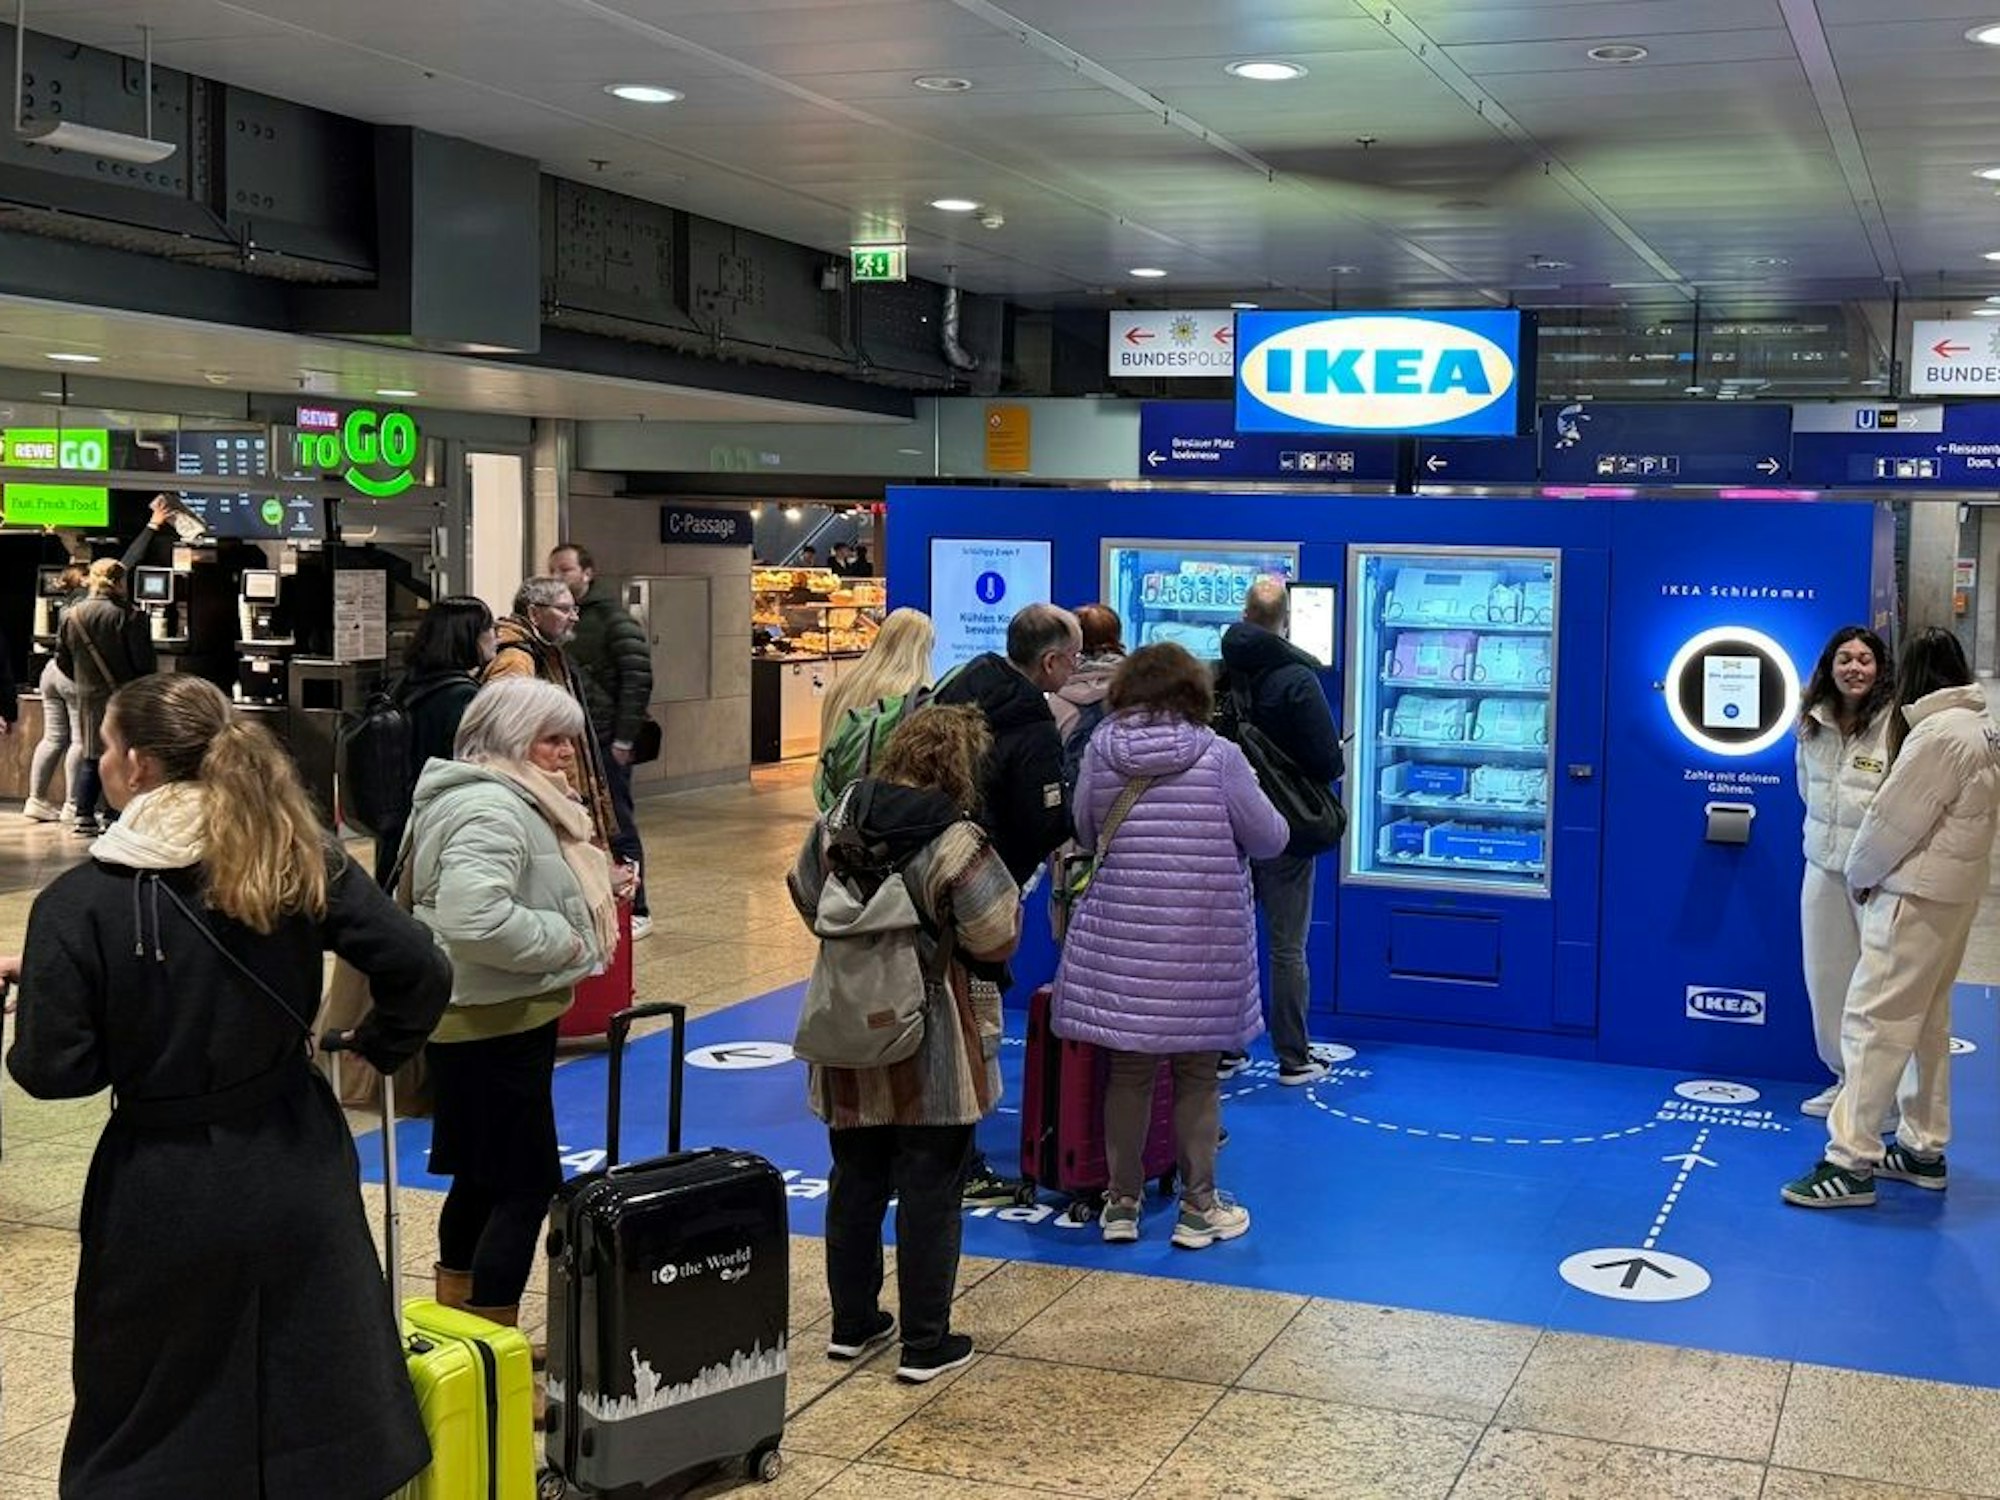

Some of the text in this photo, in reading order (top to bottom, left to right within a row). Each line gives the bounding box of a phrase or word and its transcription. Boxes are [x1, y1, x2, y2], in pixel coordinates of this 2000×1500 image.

[1121, 352, 1232, 367] BUNDESPOLIZ
[1265, 349, 1492, 396] IKEA
[300, 408, 339, 427] REWE
[1858, 410, 1874, 428] U
[297, 433, 341, 469] TO
[344, 408, 417, 468] GO
[1213, 438, 1235, 450] Platz
[15, 440, 102, 471] REWE GO
[669, 512, 737, 539] C-Passage
[1661, 585, 1816, 599] IKEA Schlafomat
[1684, 769, 1780, 785] Zahle mit deinem
[1707, 781, 1754, 795] Gähnen.
[1694, 994, 1759, 1014] IKEA
[1662, 1099, 1773, 1120] Einmal
[1655, 1110, 1792, 1132] gähnen.
[680, 1261, 702, 1278] the
[706, 1245, 751, 1270] World
